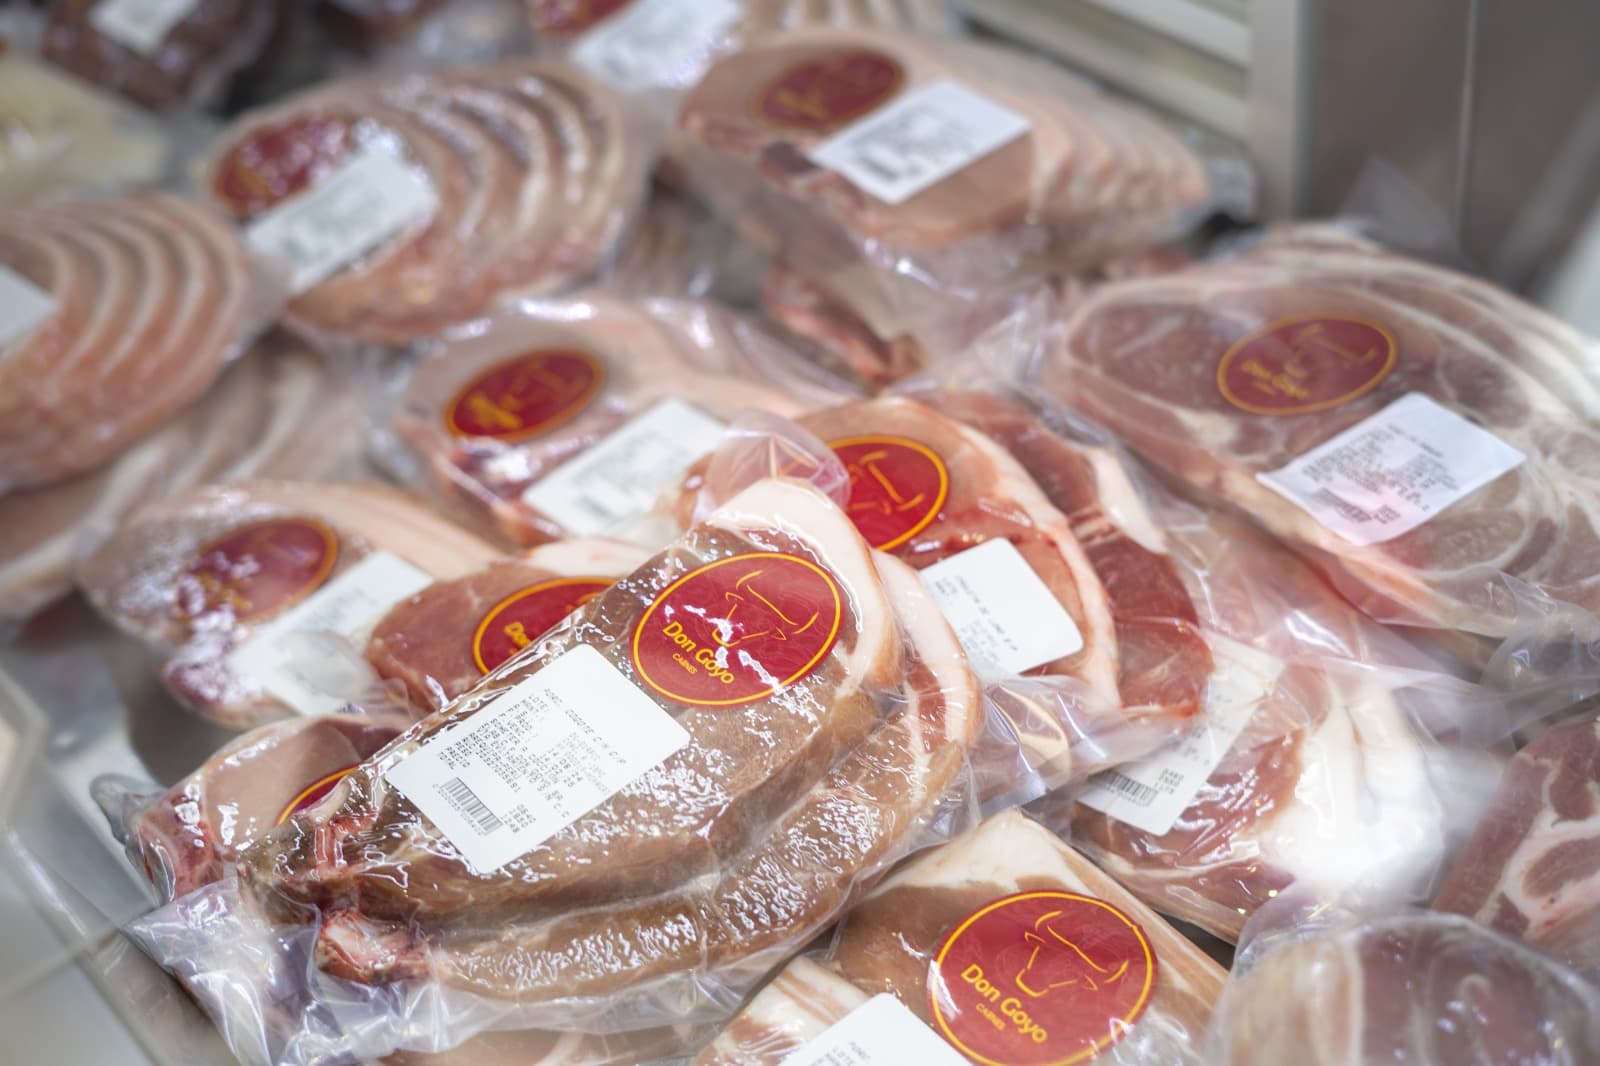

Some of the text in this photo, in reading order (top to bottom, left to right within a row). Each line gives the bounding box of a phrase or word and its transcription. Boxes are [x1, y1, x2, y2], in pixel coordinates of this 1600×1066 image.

[662, 621, 735, 685] Don Goyo
[672, 652, 698, 675] CARNES
[960, 963, 1048, 1044] Don Goyo
[975, 1002, 1007, 1032] CARNES
